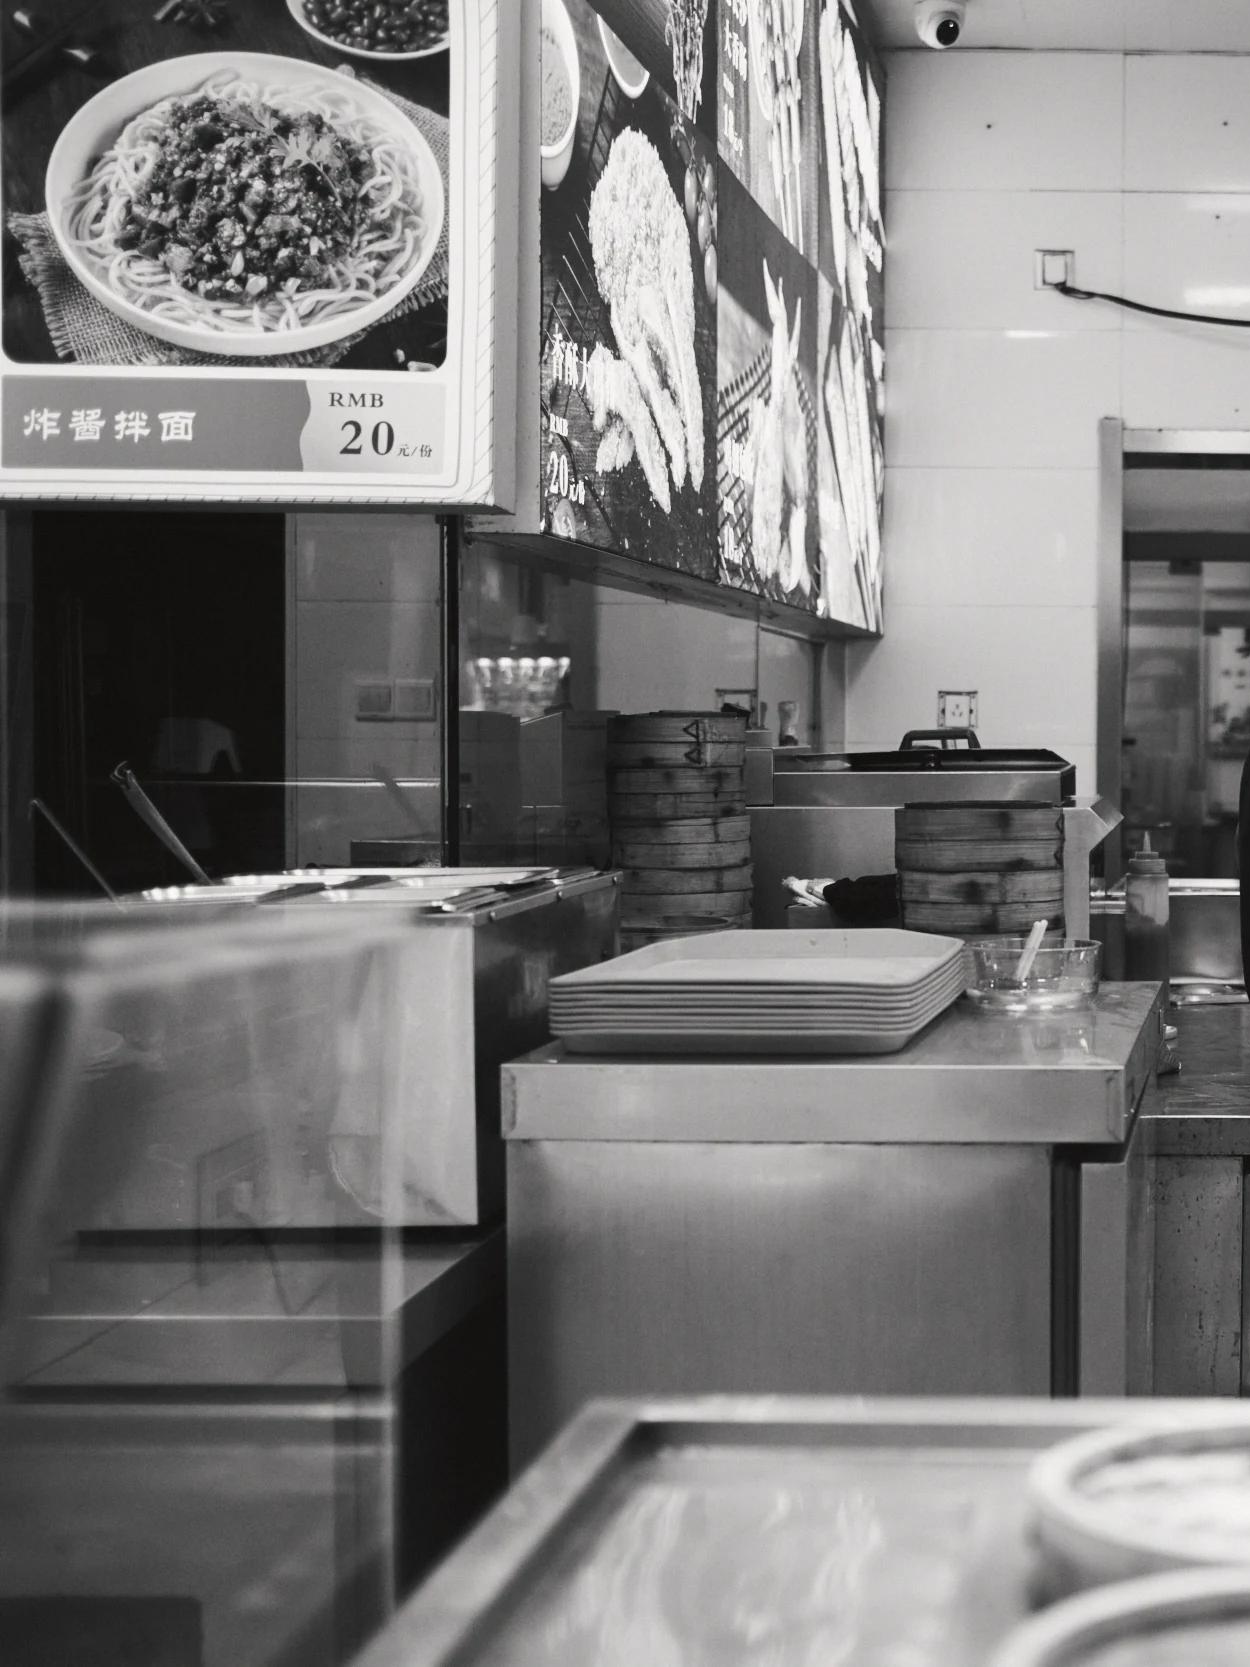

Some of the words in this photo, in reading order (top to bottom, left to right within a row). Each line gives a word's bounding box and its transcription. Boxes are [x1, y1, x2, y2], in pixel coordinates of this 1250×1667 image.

[329, 392, 385, 409] RMB
[23, 408, 197, 444] 炸酱拌面
